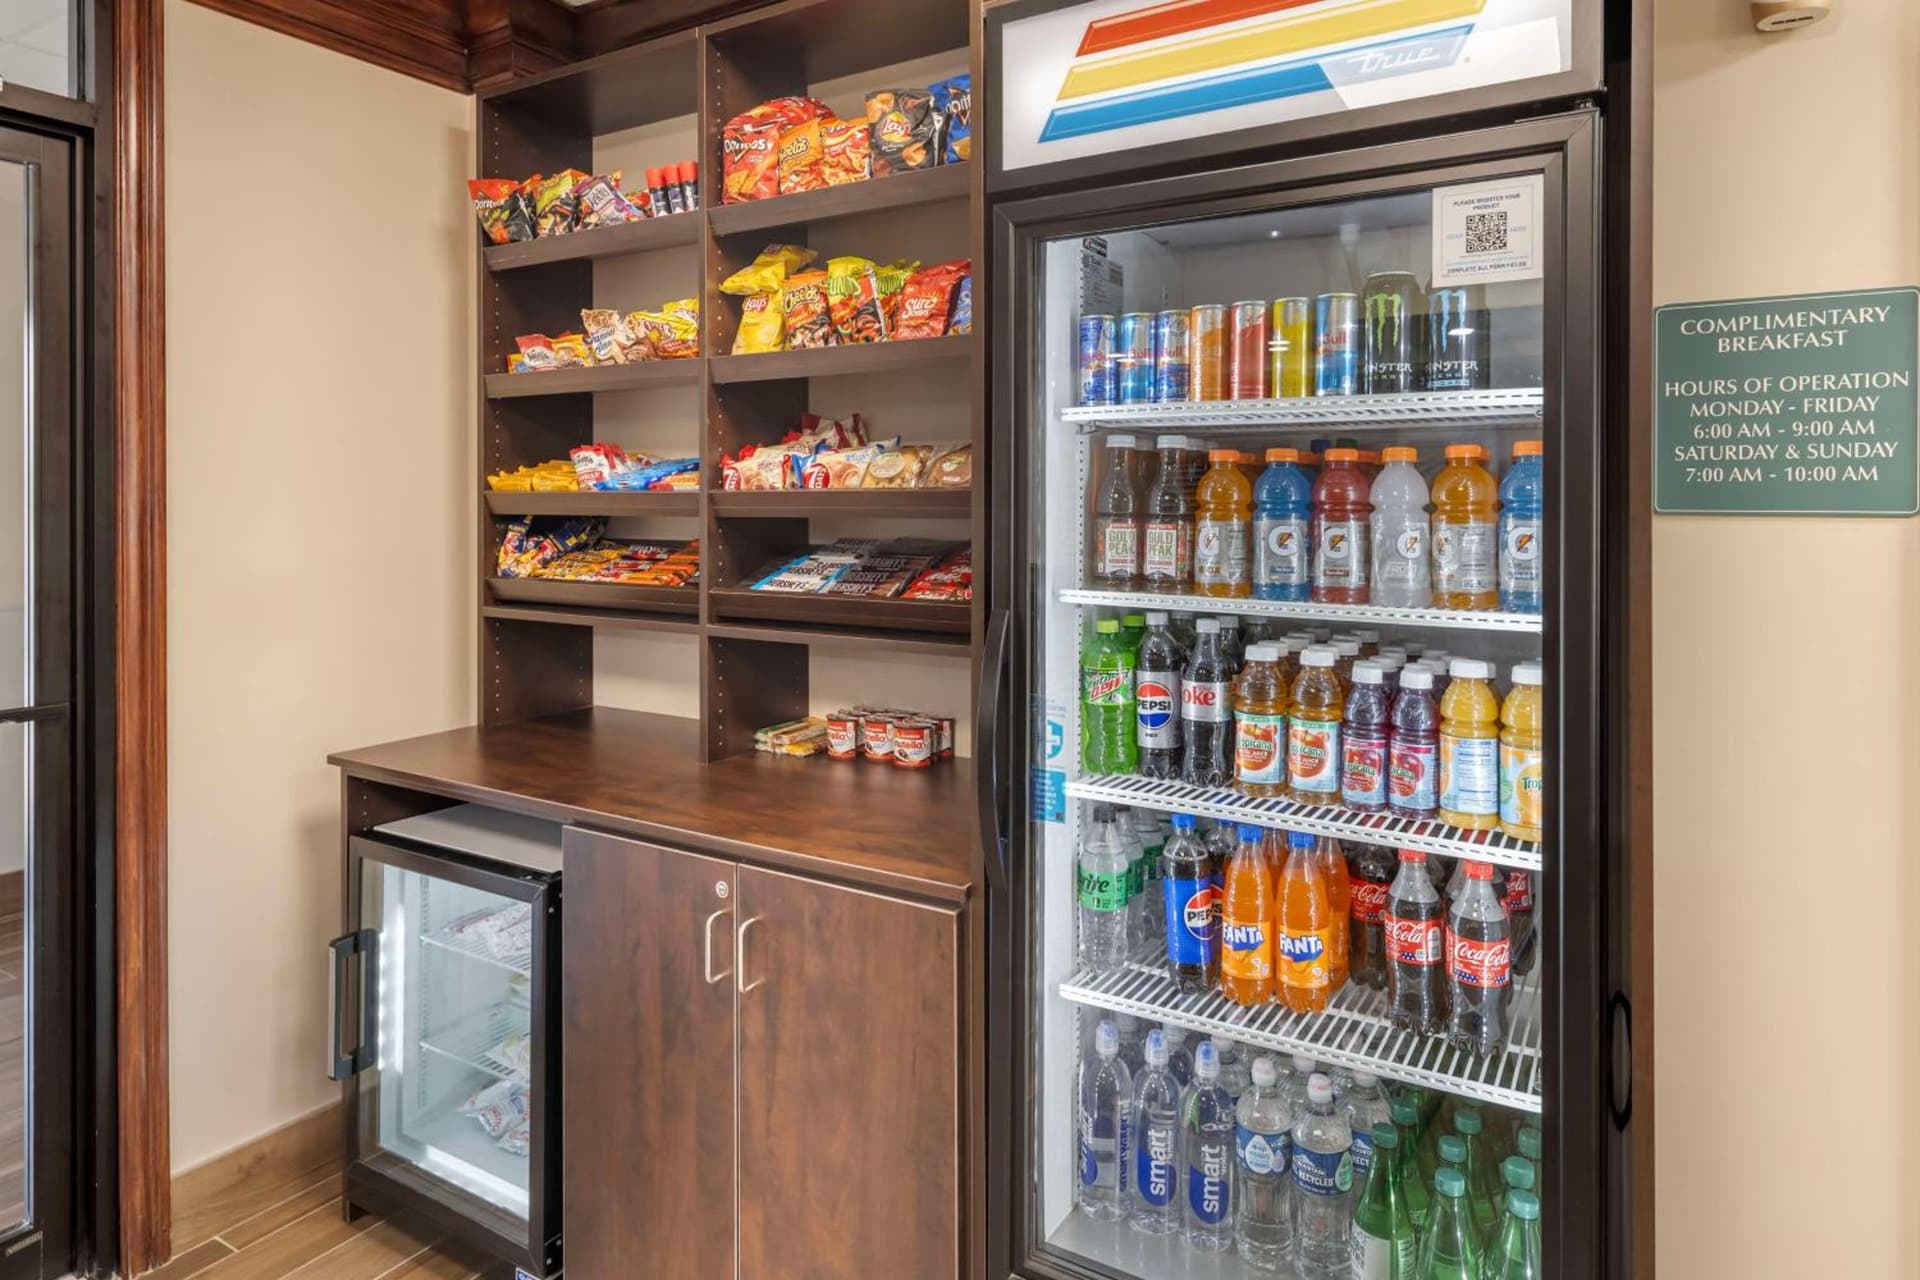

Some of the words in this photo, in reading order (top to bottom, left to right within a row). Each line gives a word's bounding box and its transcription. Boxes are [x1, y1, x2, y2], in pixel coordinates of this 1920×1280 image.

[1448, 265, 1477, 273] COMPLETE
[1680, 305, 1891, 335] COMPLIMENTARY
[1718, 329, 1848, 353] BREAKFAST
[1370, 362, 1412, 373] NSTER
[1665, 378, 1737, 397] HOURS
[1744, 377, 1773, 394] OF
[1779, 370, 1909, 392] OPERATION
[1690, 399, 1784, 418] MONDAY
[1803, 396, 1880, 414] FRIDAY
[1693, 423, 1732, 439] 6:00
[1737, 422, 1771, 438] AM
[1792, 421, 1833, 437] 9:00
[1839, 419, 1875, 435] AM
[1674, 443, 1779, 461] SATURDAY
[1785, 443, 1800, 459] &
[1807, 441, 1899, 459] SUNDAY
[1685, 467, 1724, 482] 7:00
[1729, 467, 1762, 482] AM
[1784, 466, 1836, 482] 10:00
[1841, 465, 1878, 481] AM
[1183, 686, 1216, 706] oke
[1223, 923, 1264, 944] FANTA
[1280, 933, 1323, 954] FANTA
[1149, 1128, 1166, 1196] smart
[1202, 1144, 1220, 1213] smart
